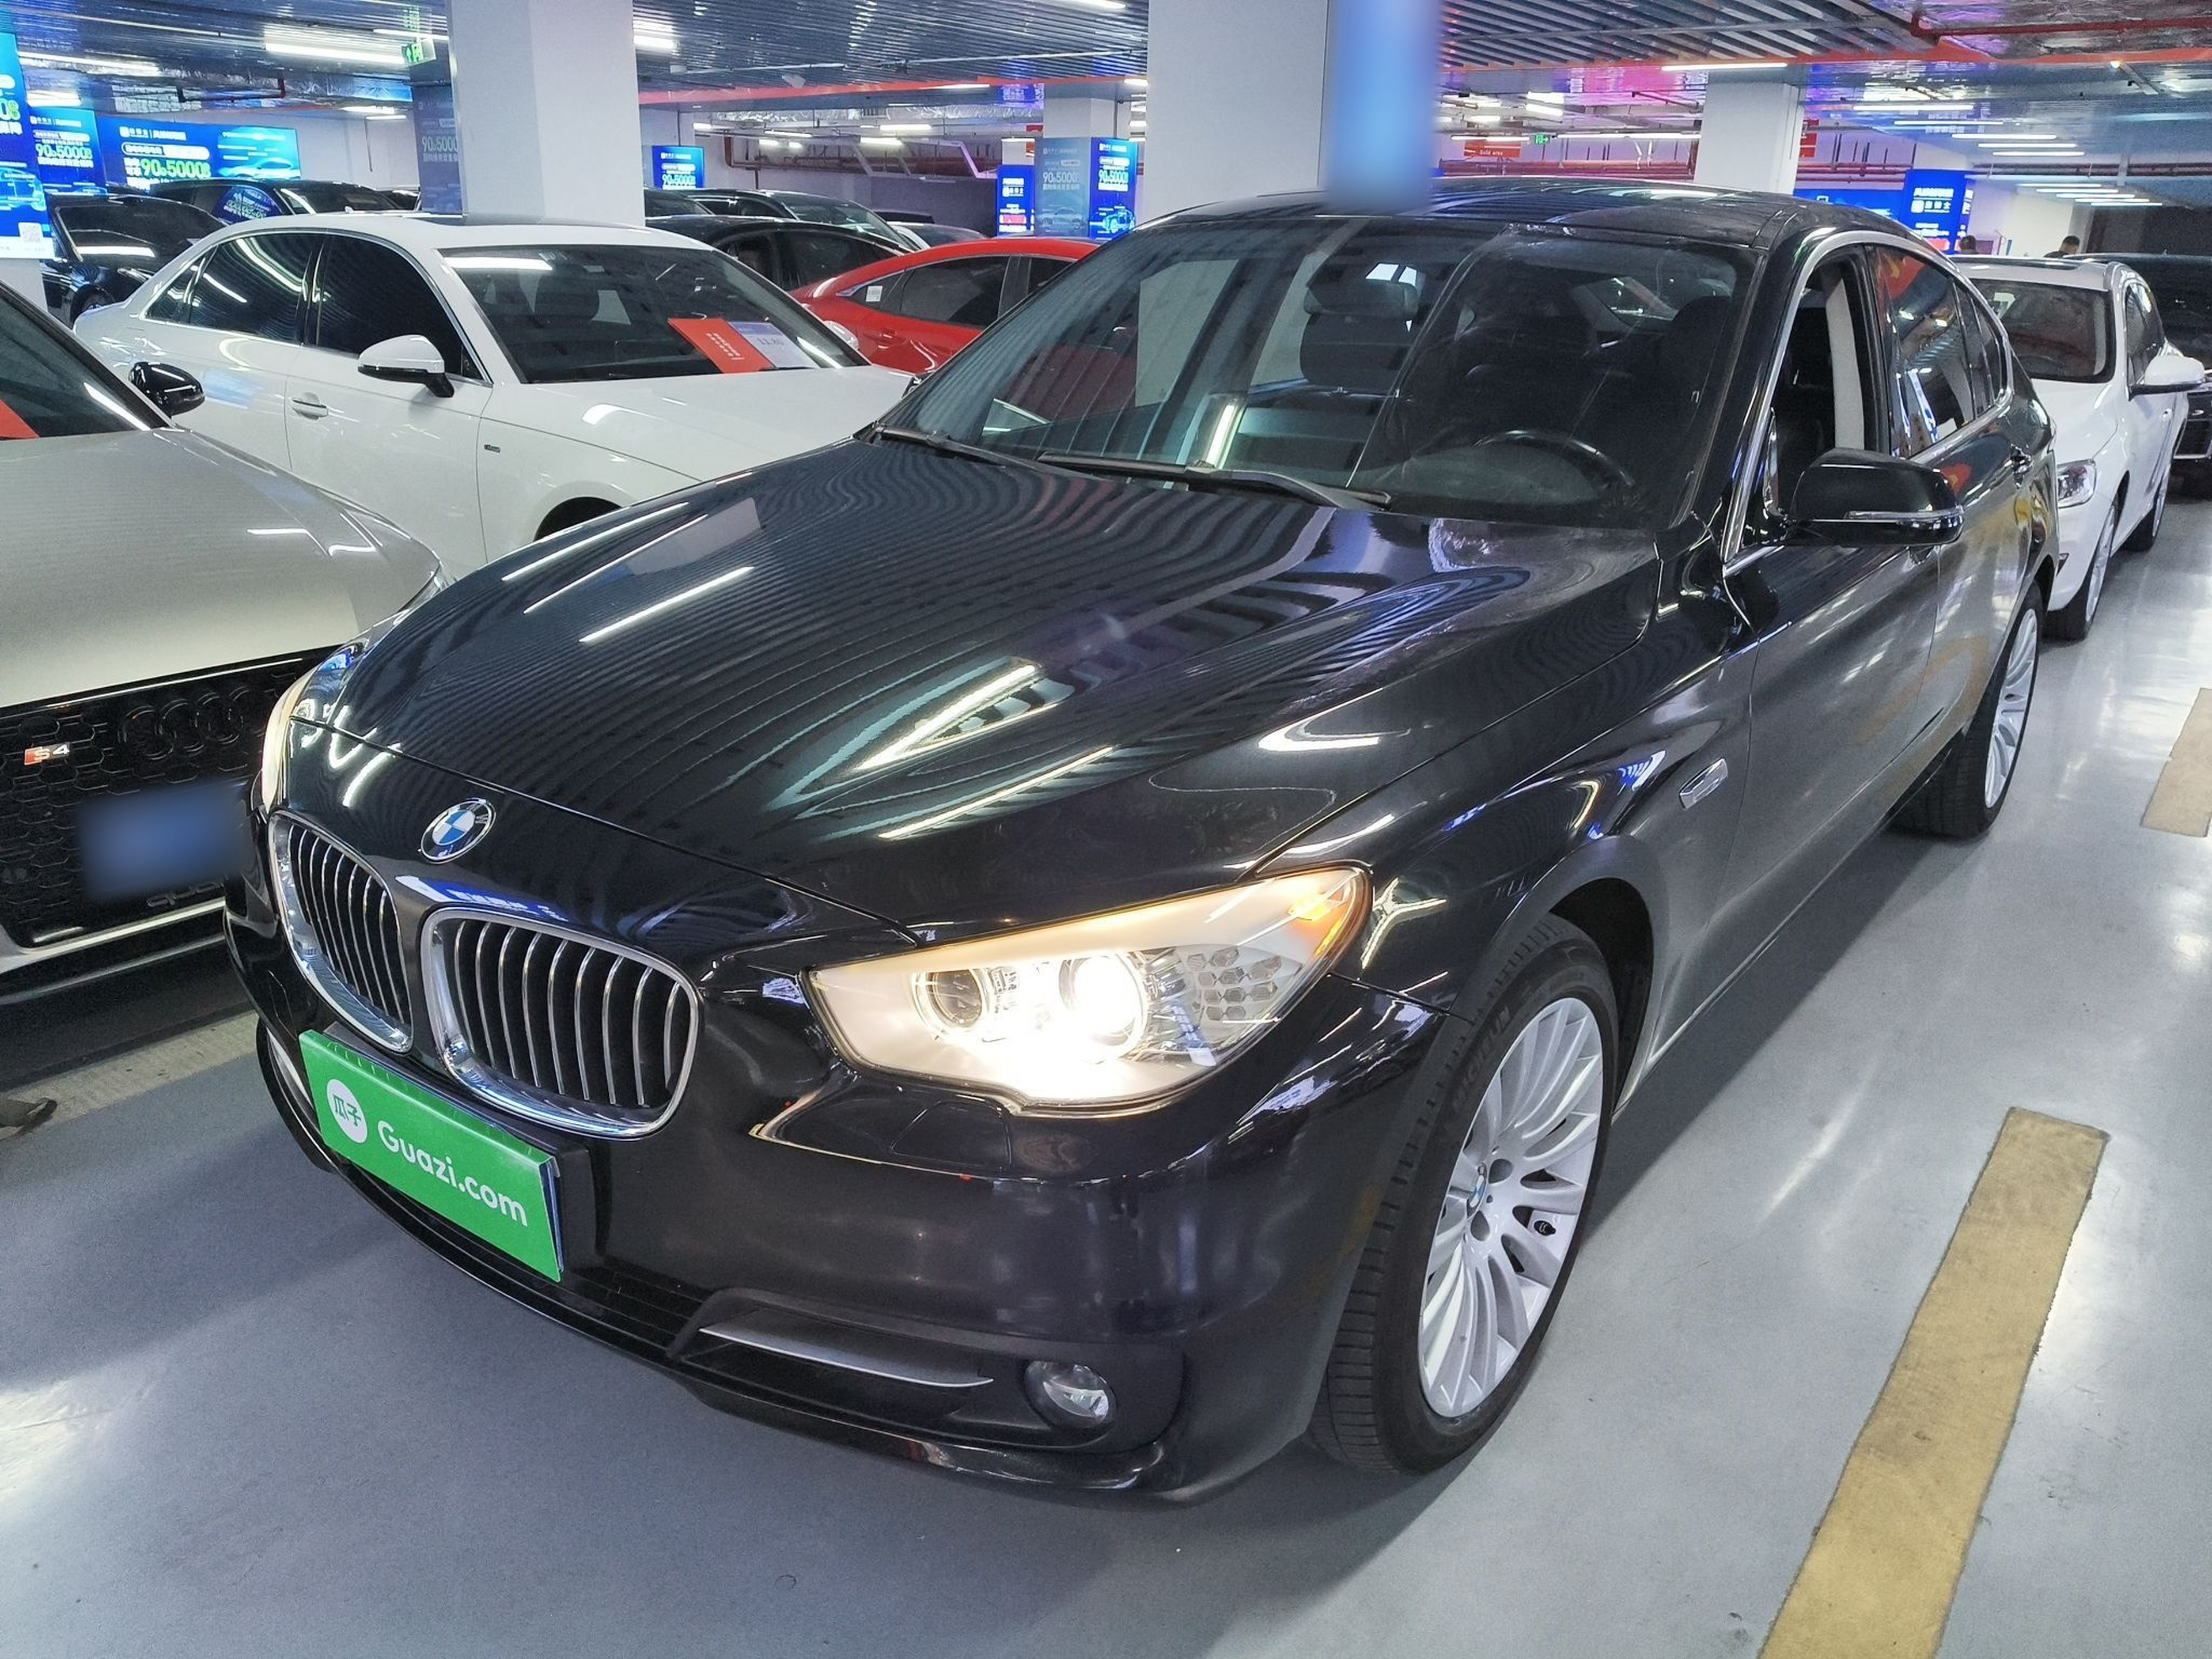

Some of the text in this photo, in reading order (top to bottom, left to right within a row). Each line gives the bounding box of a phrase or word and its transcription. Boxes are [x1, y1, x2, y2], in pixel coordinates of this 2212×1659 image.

[33, 744, 70, 761] S4
[332, 1093, 362, 1127] 瓜子
[378, 1120, 528, 1227] Guazi.com
